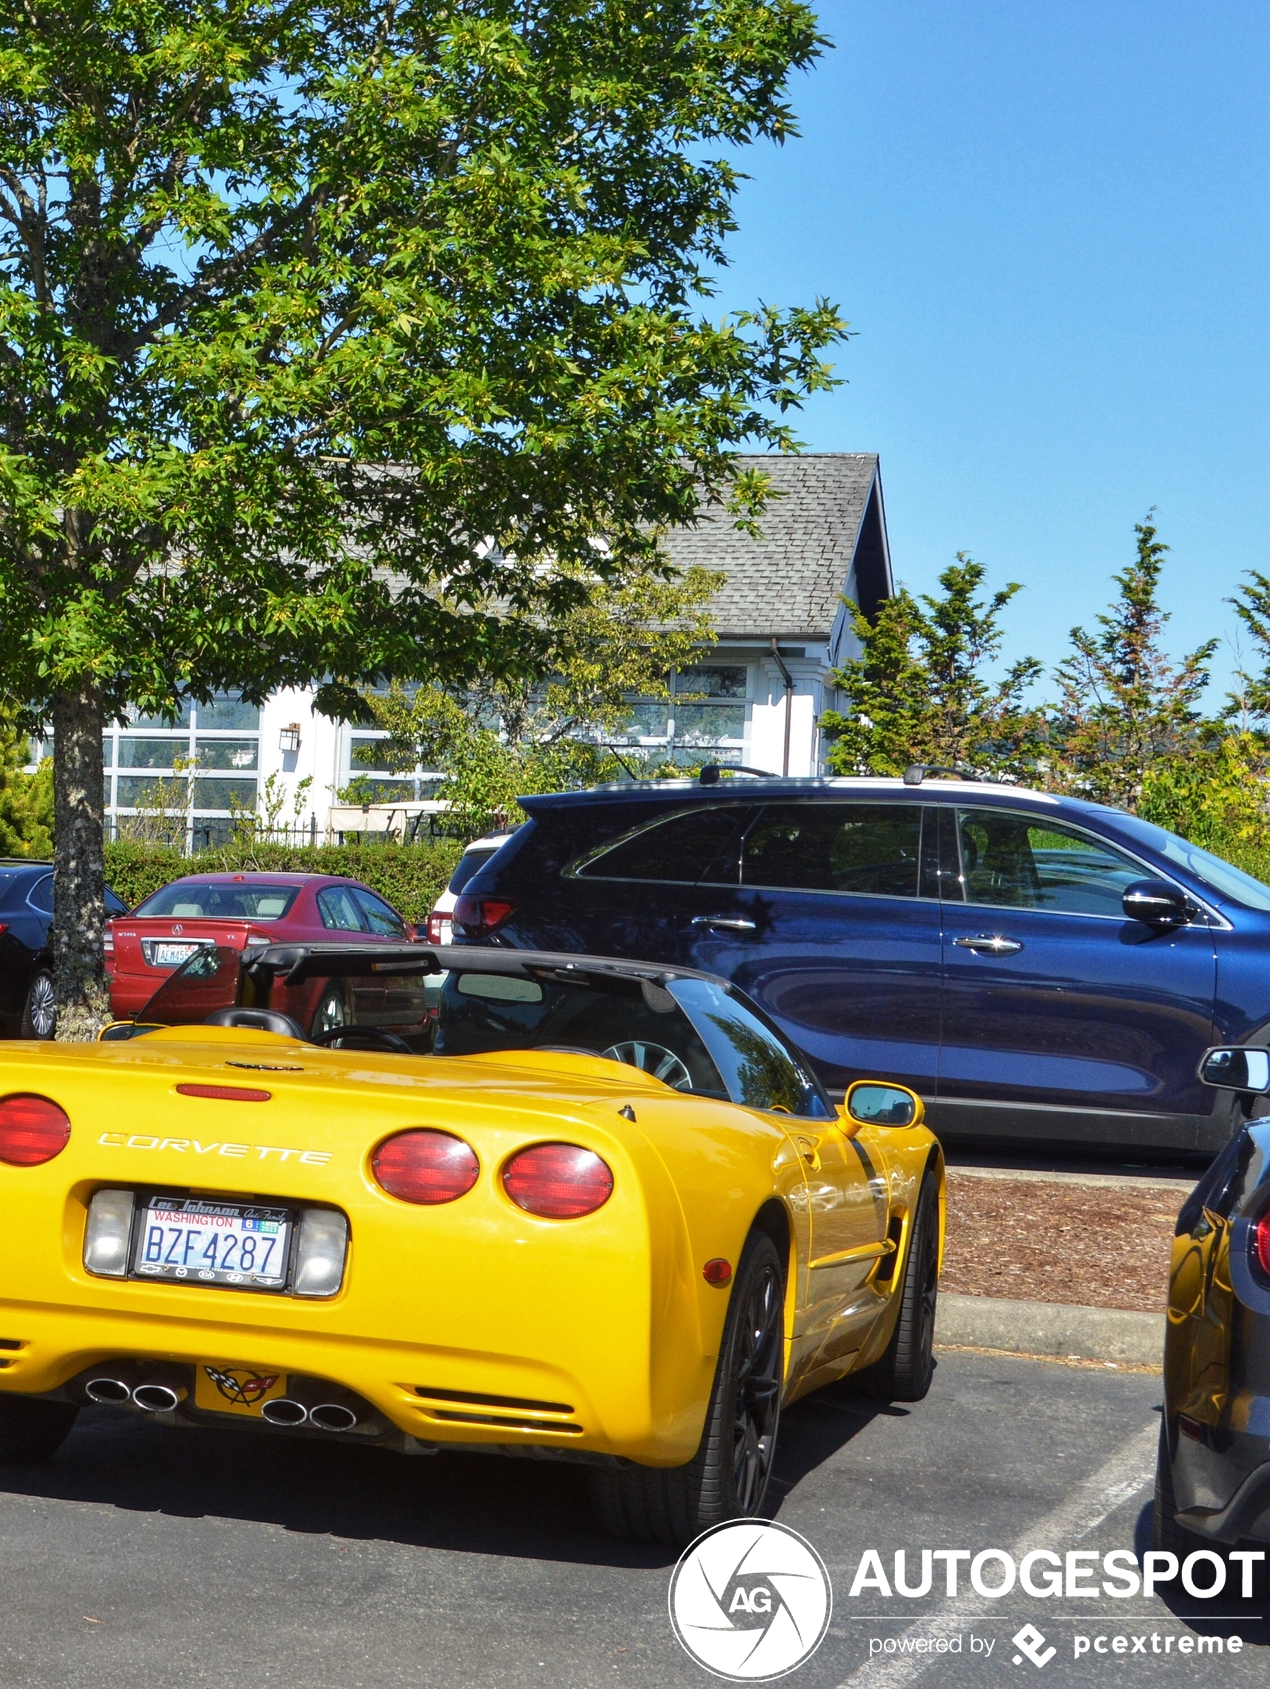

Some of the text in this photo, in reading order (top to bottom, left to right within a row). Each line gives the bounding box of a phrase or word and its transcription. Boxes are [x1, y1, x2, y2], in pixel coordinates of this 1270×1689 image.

[97, 1131, 334, 1165] CORVETTE
[154, 1210, 234, 1228] WASHINGTON
[178, 1199, 240, 1217] Johnson
[263, 1209, 286, 1226] Family
[245, 1219, 254, 1229] 6
[260, 1225, 278, 1233] 2023
[145, 1225, 277, 1273] BZF4287
